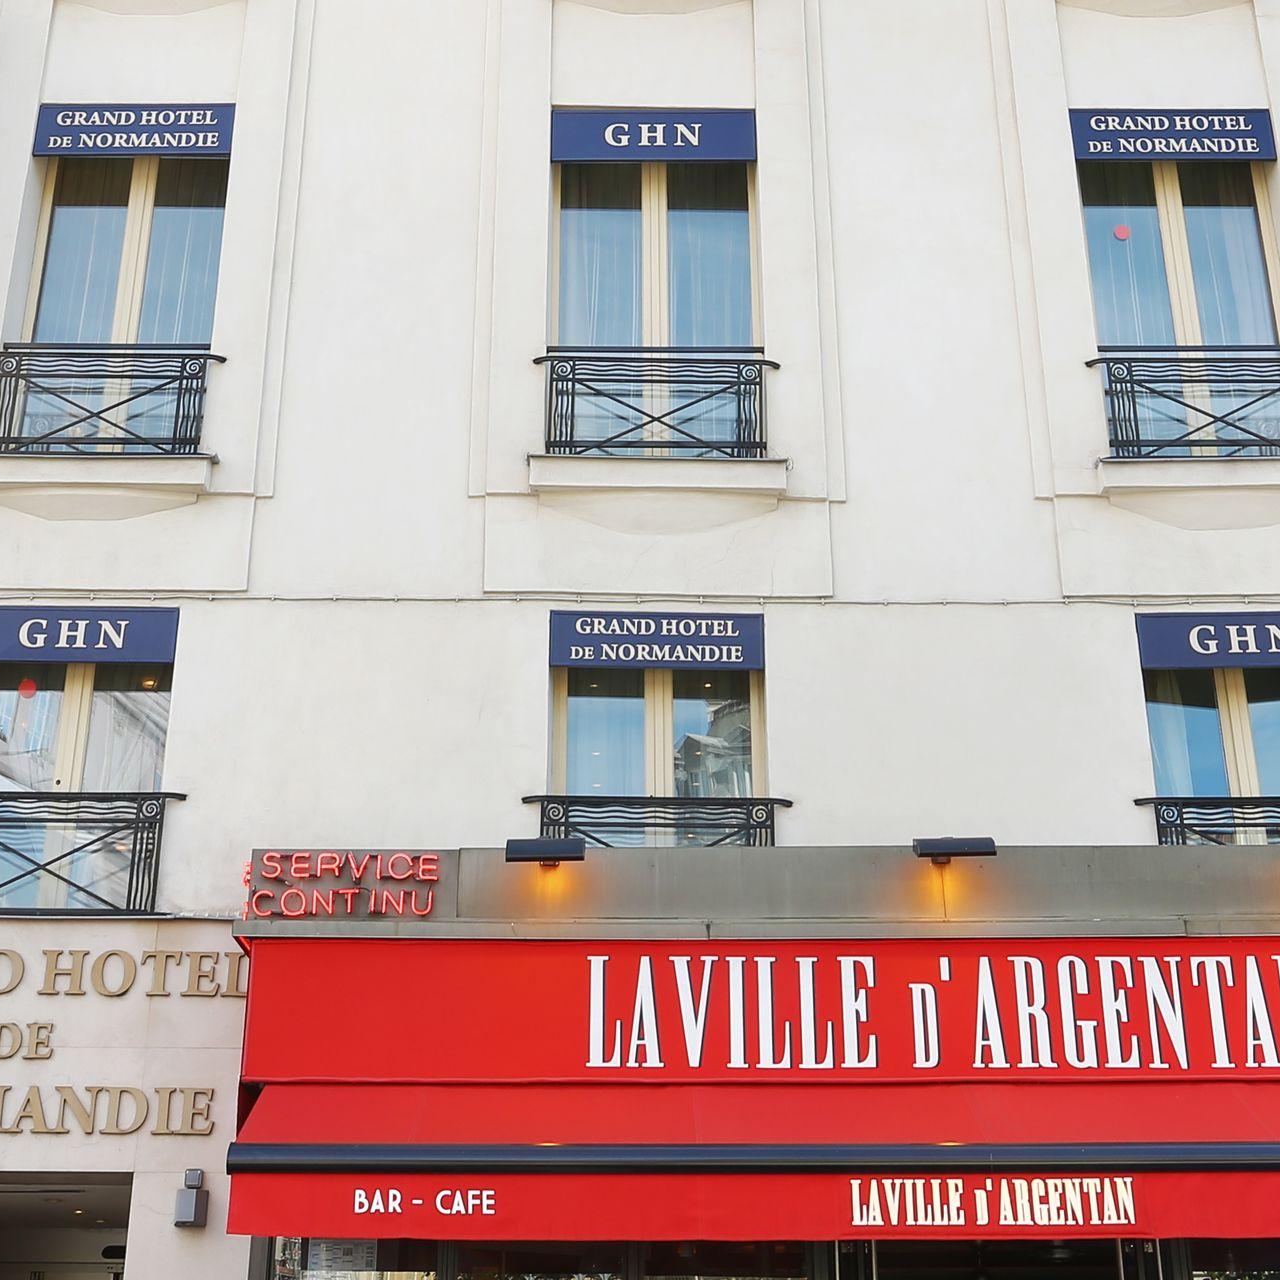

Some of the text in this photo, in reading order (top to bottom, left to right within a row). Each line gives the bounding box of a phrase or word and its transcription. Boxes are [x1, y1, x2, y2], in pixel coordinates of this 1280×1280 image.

[56, 110, 218, 126] GRAND HOTEL
[1090, 115, 1252, 131] GRAND HOTEL
[47, 132, 219, 148] DE NORMANDIE
[604, 123, 702, 147] GHN
[1088, 138, 1260, 153] DE NORMANDIE
[18, 618, 130, 649] GHN
[575, 617, 740, 637] GRAND HOTEL
[569, 643, 744, 662] DE NORMANDIE
[261, 851, 439, 881] SERVICE
[252, 888, 434, 917] CONTINU
[354, 1189, 402, 1214] BAR
[435, 1189, 495, 1215] CAFE
